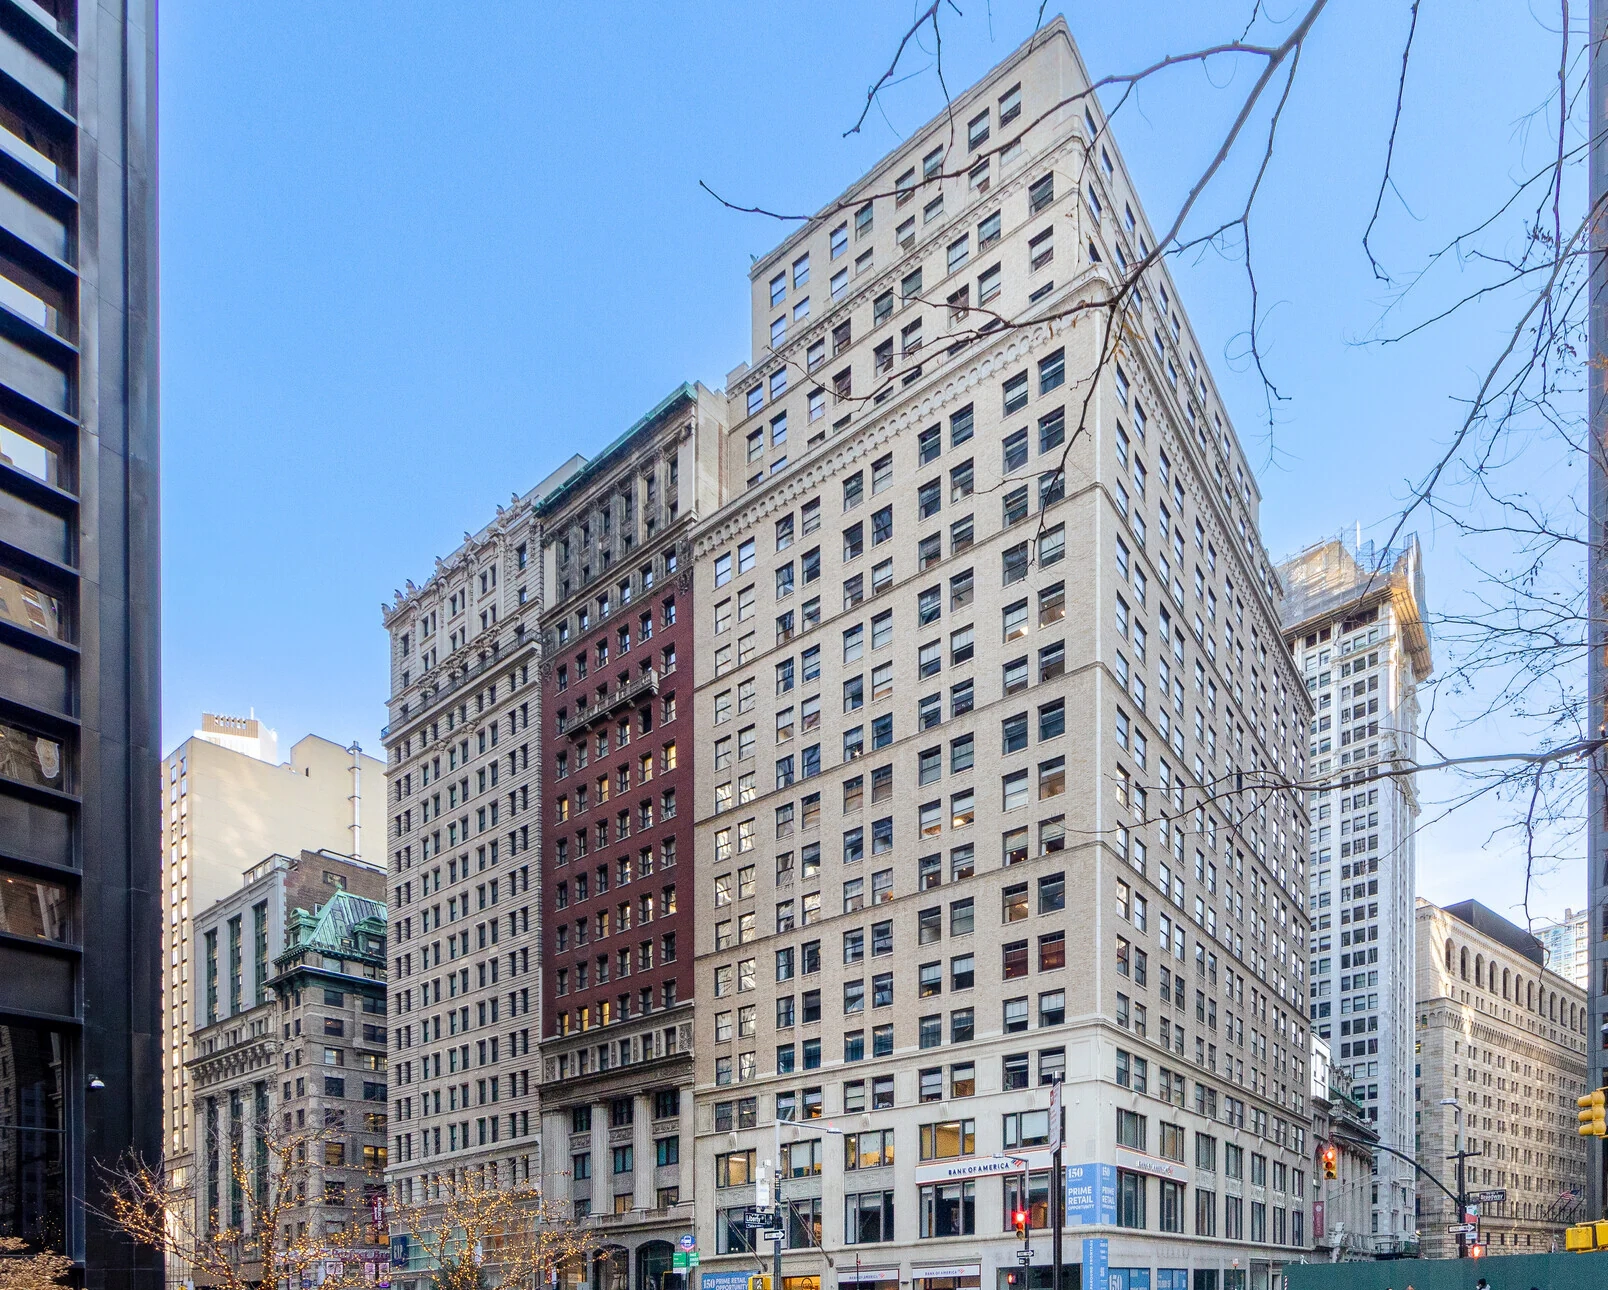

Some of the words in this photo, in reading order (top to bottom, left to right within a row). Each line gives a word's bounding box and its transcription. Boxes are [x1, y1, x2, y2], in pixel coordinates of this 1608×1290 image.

[948, 1168, 967, 1176] BANK
[977, 1162, 1010, 1172] AMERICA
[1068, 1167, 1083, 1178] 150
[1102, 1166, 1111, 1177] 150
[1068, 1186, 1092, 1196] PRIME
[1068, 1195, 1093, 1204] RETAIL
[703, 1278, 716, 1289] 150
[716, 1277, 731, 1285] PRIME
